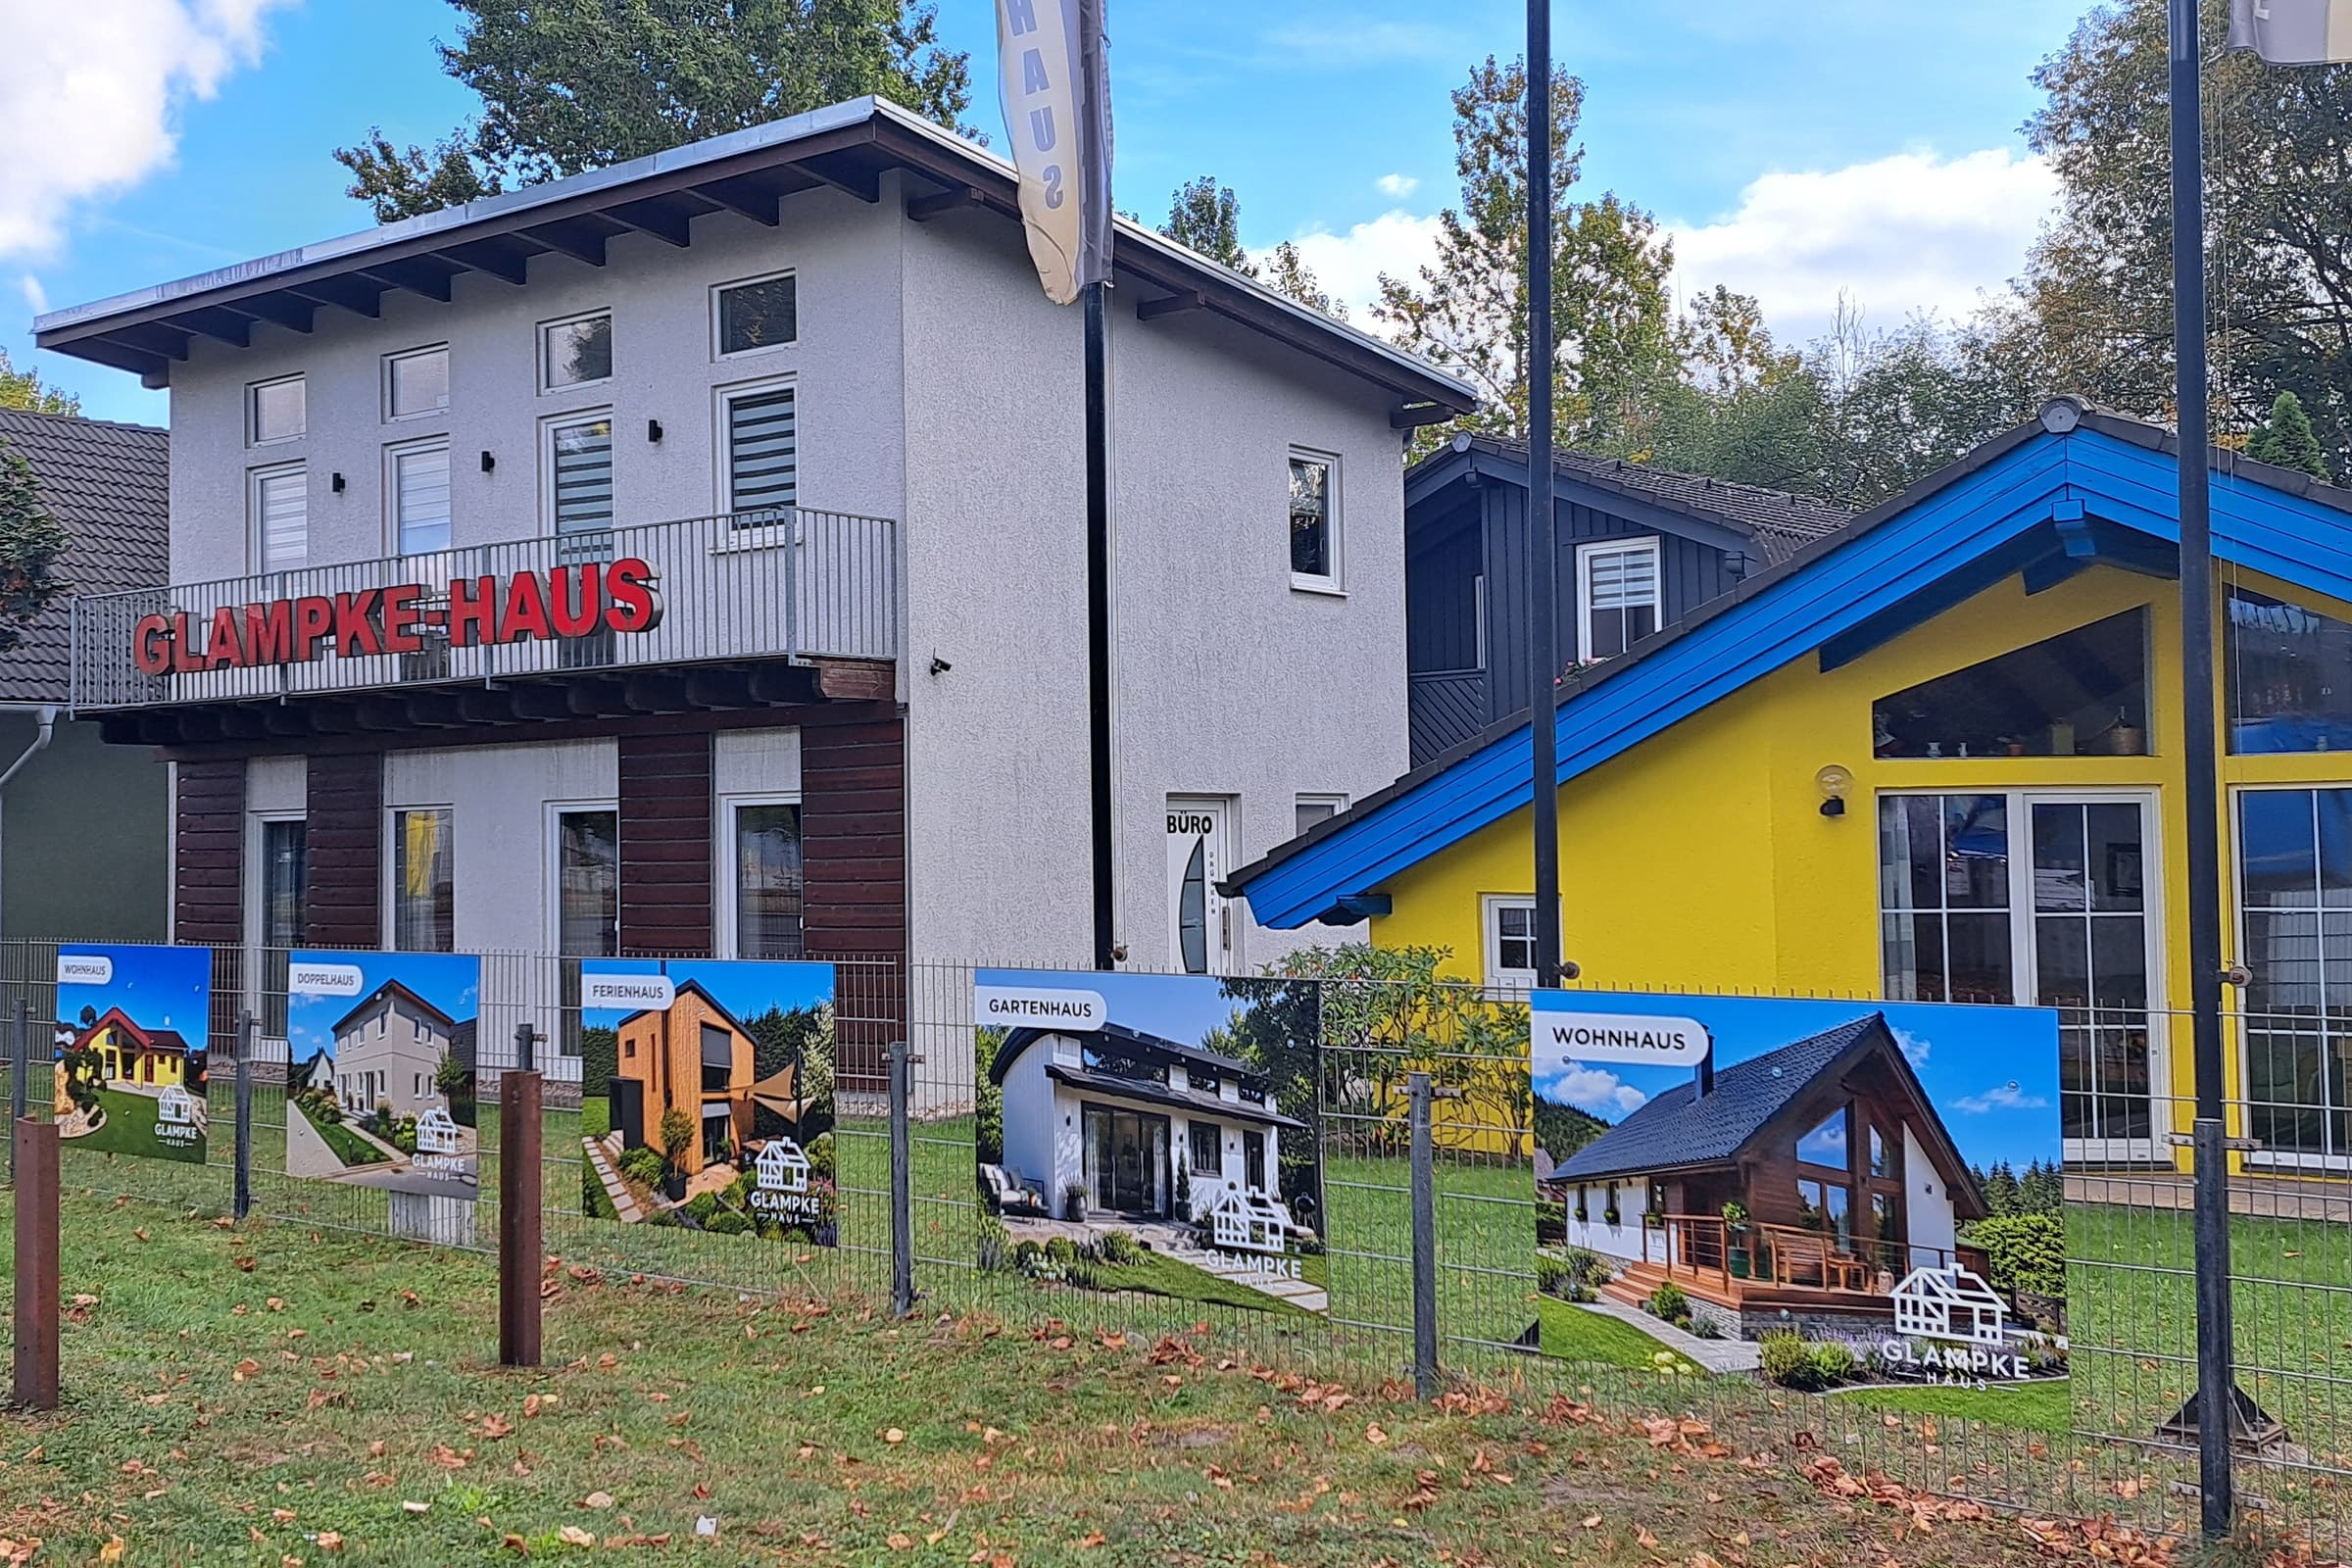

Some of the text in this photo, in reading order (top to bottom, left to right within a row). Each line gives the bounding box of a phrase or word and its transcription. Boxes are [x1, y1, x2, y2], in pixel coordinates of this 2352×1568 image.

[134, 557, 662, 676] GLAMPKE-HAUS
[1166, 809, 1212, 834] BÜRO
[64, 963, 106, 976] WOHNHAUS
[297, 972, 355, 987] DOPPELHAUS
[592, 985, 664, 999] FERIENHAUS
[989, 999, 1092, 1017] GARTENHAUS
[1552, 1026, 1686, 1051] WOHNHAUS
[154, 1122, 197, 1140] GLAMPKE
[412, 1152, 466, 1172] GLAMPKE
[750, 1191, 820, 1215] GLAMPKE
[770, 1211, 801, 1225] HAUS
[1205, 1249, 1302, 1280] GLAMPKE
[1882, 1339, 2031, 1380] GLAMPKE
[1927, 1371, 1987, 1392] HAUS
